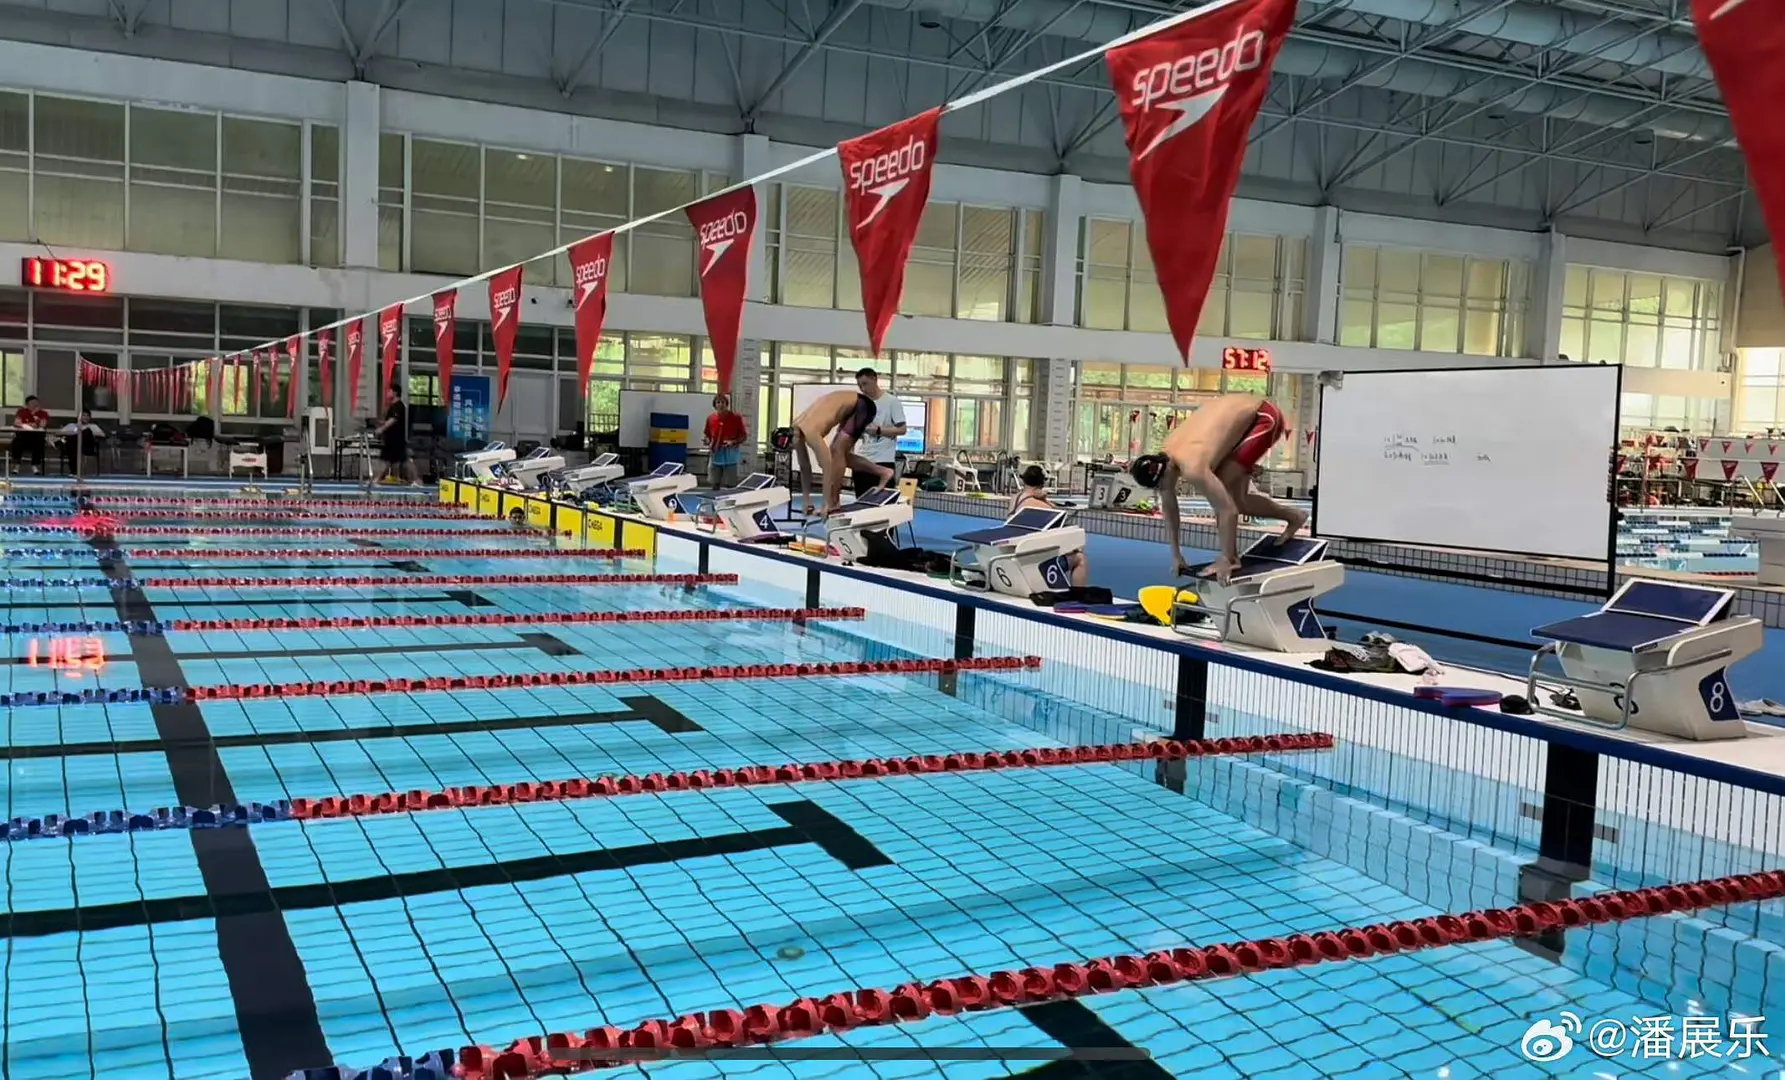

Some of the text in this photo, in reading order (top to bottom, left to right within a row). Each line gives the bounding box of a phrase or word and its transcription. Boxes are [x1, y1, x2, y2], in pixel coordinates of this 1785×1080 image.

[1132, 24, 1264, 113] speedo
[850, 134, 925, 196] speedo
[700, 208, 747, 250] speedo
[33, 260, 106, 291] 11:29
[1224, 347, 1268, 371] 57:12
[759, 515, 769, 529] 4
[996, 566, 1012, 587] 6
[1046, 564, 1058, 585] 6
[1298, 608, 1311, 632] 7
[1710, 681, 1725, 713] 8
